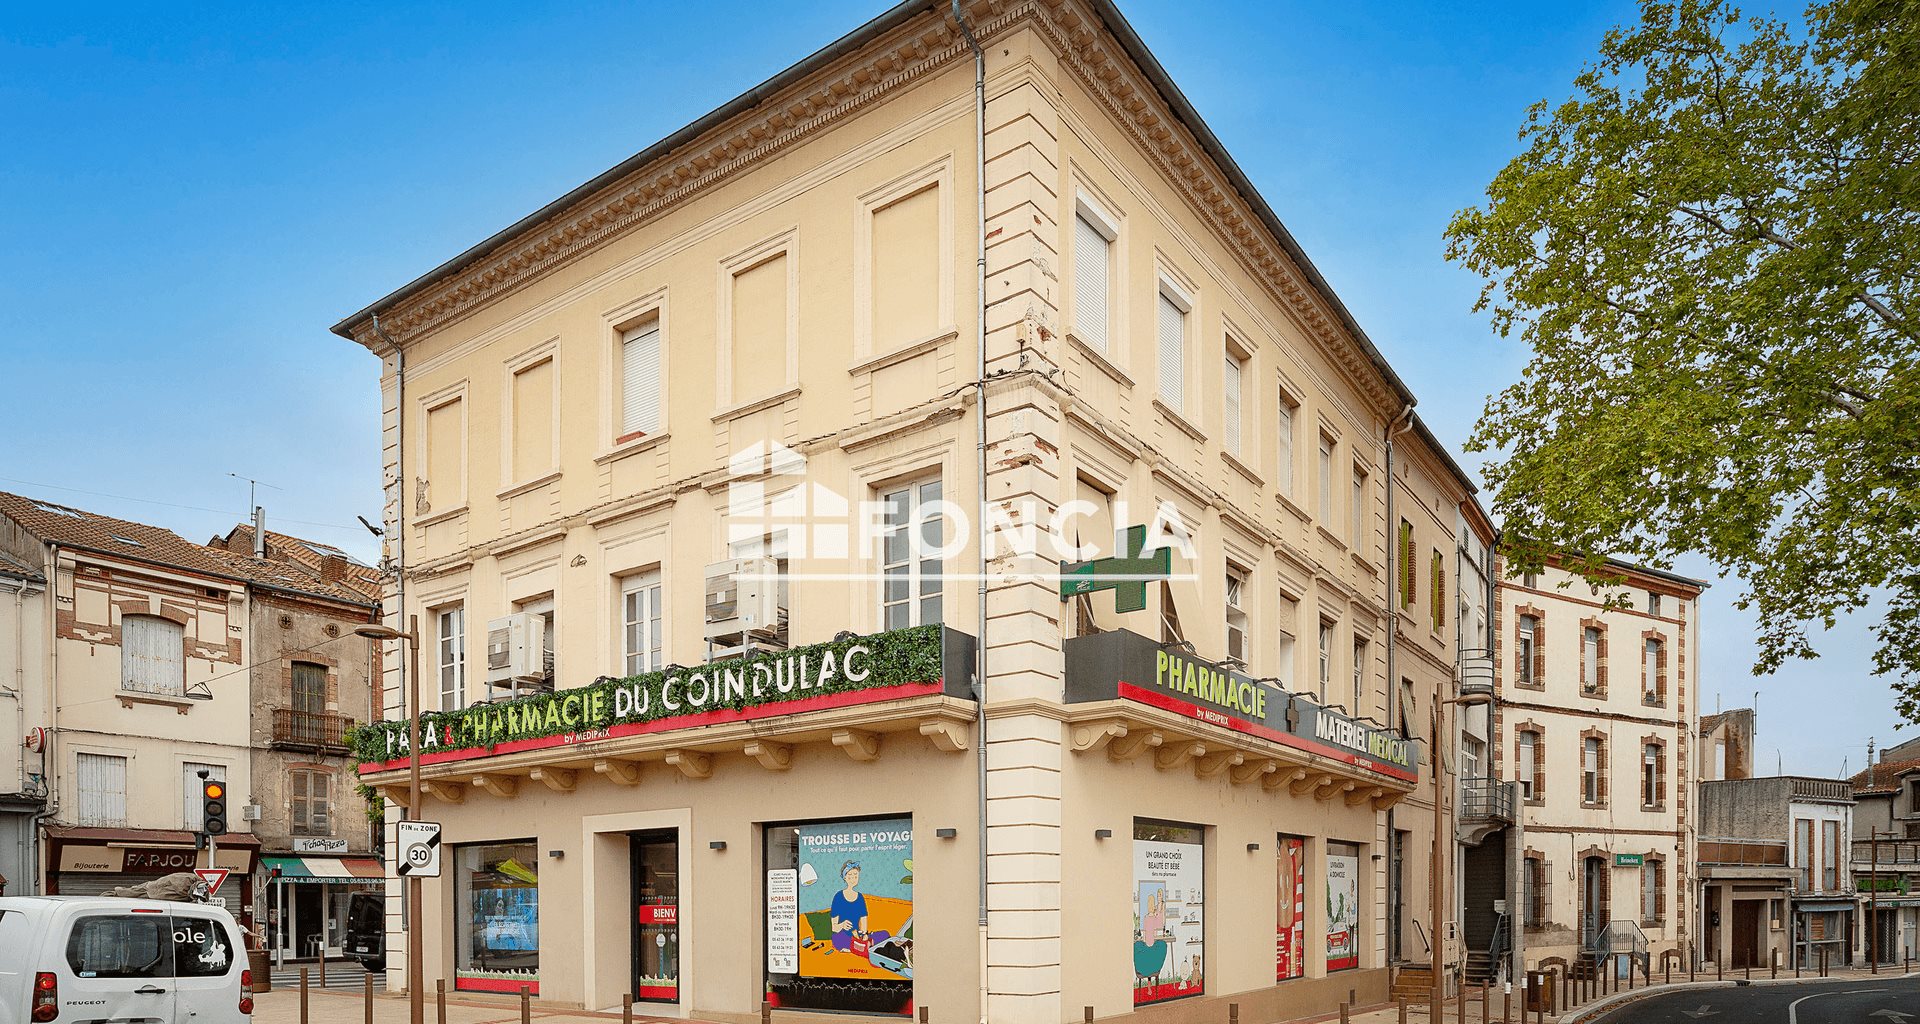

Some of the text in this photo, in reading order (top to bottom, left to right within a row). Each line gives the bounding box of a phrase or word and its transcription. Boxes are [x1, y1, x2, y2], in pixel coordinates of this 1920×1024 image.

[1156, 649, 1266, 719] PHARMACIE
[386, 721, 438, 754] PAA
[461, 691, 605, 742] PHARMACIE
[615, 684, 649, 718] DU
[1196, 707, 1229, 726] by MEDIPRIX
[564, 734, 574, 744] by
[1315, 711, 1409, 767] MATERIEL MEDICAL
[801, 834, 850, 846] TROUSSE
[852, 833, 867, 844] DE
[411, 849, 427, 861] 30
[73, 862, 110, 870] Bijouterie
[173, 927, 206, 944] ole
